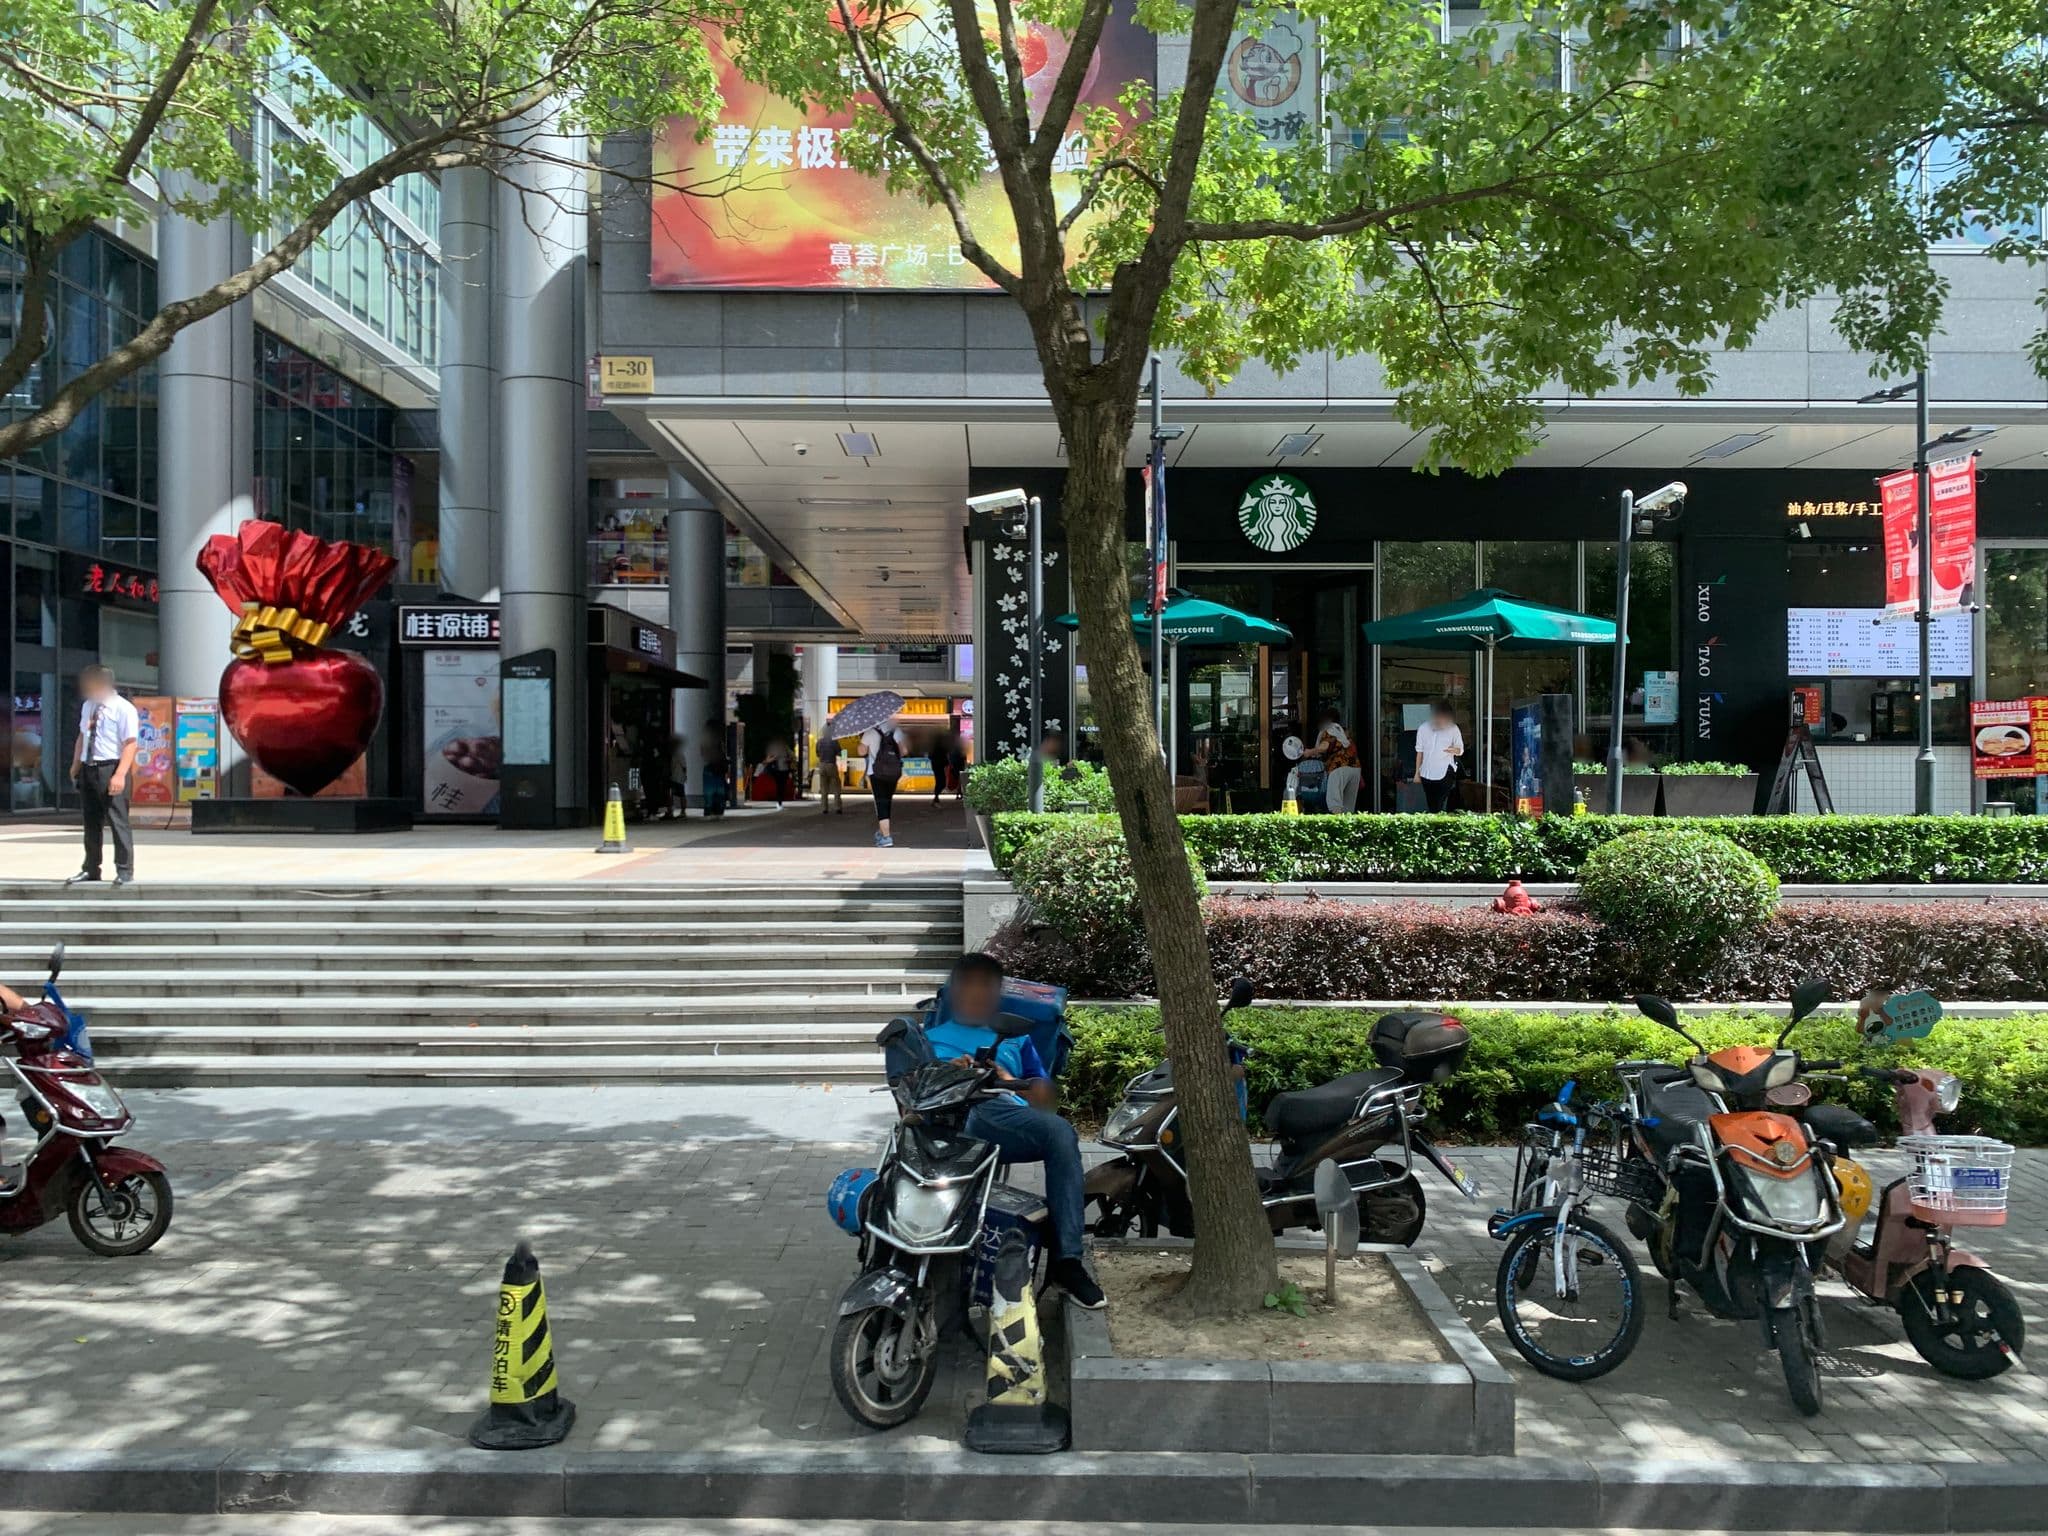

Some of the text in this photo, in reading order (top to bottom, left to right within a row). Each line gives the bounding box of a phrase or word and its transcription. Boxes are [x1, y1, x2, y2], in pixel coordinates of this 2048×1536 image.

[607, 361, 648, 376] 1-30
[1698, 585, 1710, 623] XIAO
[406, 613, 489, 638] 桂源铺
[1699, 646, 1711, 677] TAO
[1699, 696, 1711, 740] YUAN
[492, 1319, 512, 1393] 请勿泊车
